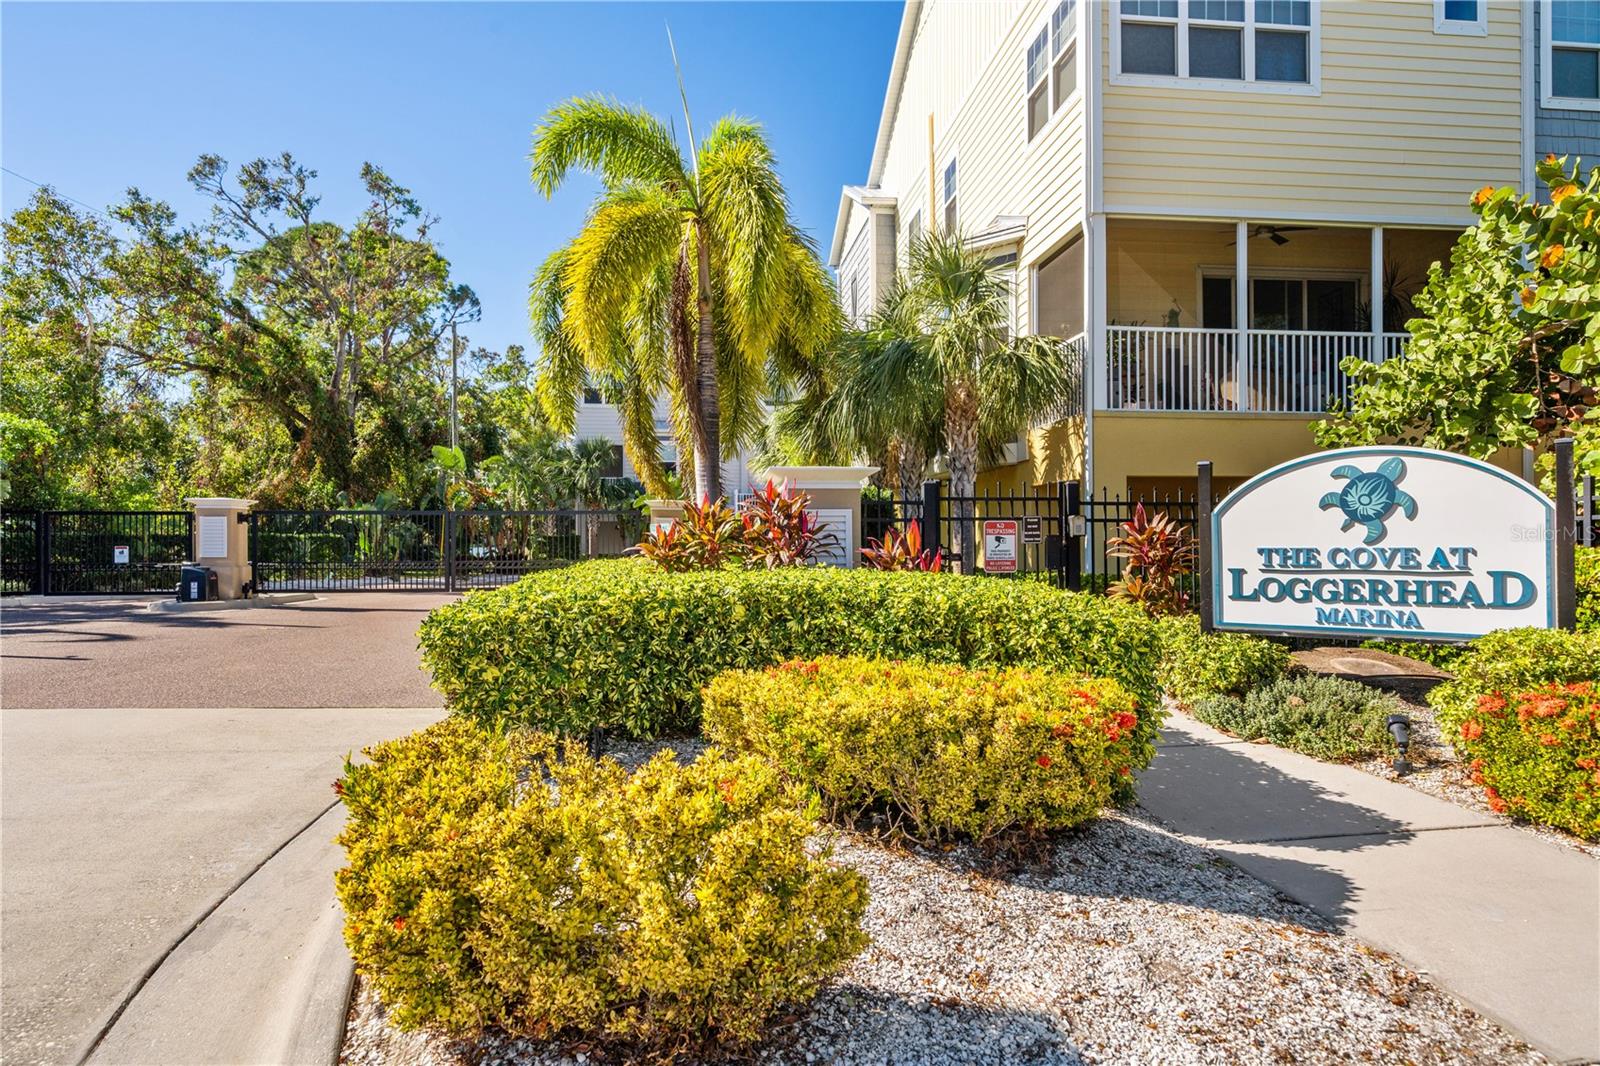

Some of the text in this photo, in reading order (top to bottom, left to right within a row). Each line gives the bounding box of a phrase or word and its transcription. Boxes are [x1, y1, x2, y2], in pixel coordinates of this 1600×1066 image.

[1257, 547, 1477, 571] THE COVE AT
[1228, 568, 1538, 610] LOGGERHEAD
[1315, 607, 1424, 630] MARINA
